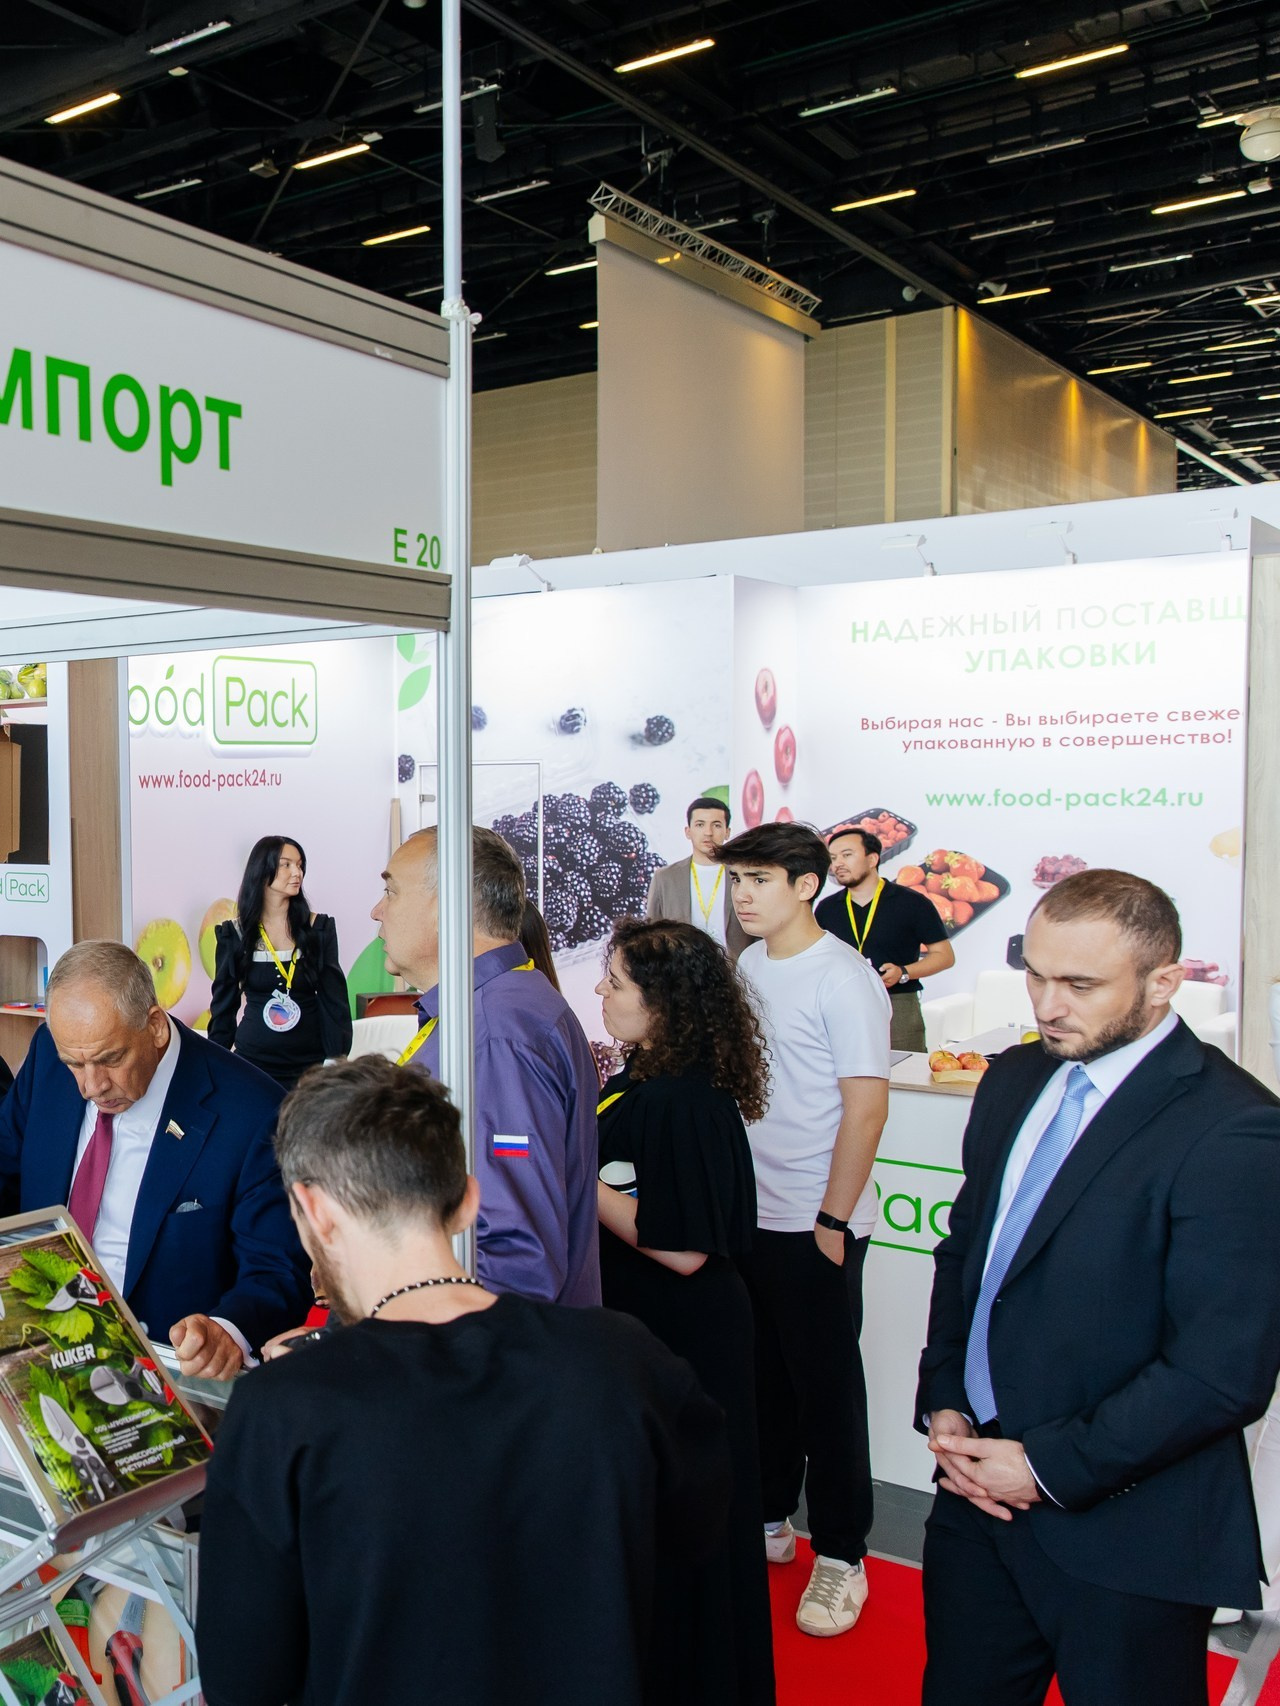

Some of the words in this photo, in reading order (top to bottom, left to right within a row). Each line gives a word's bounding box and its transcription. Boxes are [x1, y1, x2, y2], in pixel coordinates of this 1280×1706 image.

[394, 527, 407, 564] E
[416, 533, 441, 570] 20
[851, 604, 1041, 643] НАДЕЖНЫЙ
[964, 641, 1156, 673] УПАКОВКИ
[225, 676, 309, 728] Pack
[860, 716, 942, 733] Выбирая
[949, 716, 984, 728] нас
[1006, 713, 1031, 727] Вы
[1038, 710, 1159, 728] выбираете
[902, 737, 1035, 754] упакованную
[1042, 736, 1052, 748] в
[1059, 728, 1232, 750] совершенство!
[138, 769, 282, 792] www.food-pack24.ru
[925, 787, 1204, 811] www.food-pack24.ru
[10, 879, 46, 897] Pack
[873, 1180, 954, 1239] ac
[50, 1343, 96, 1370] KUKER
